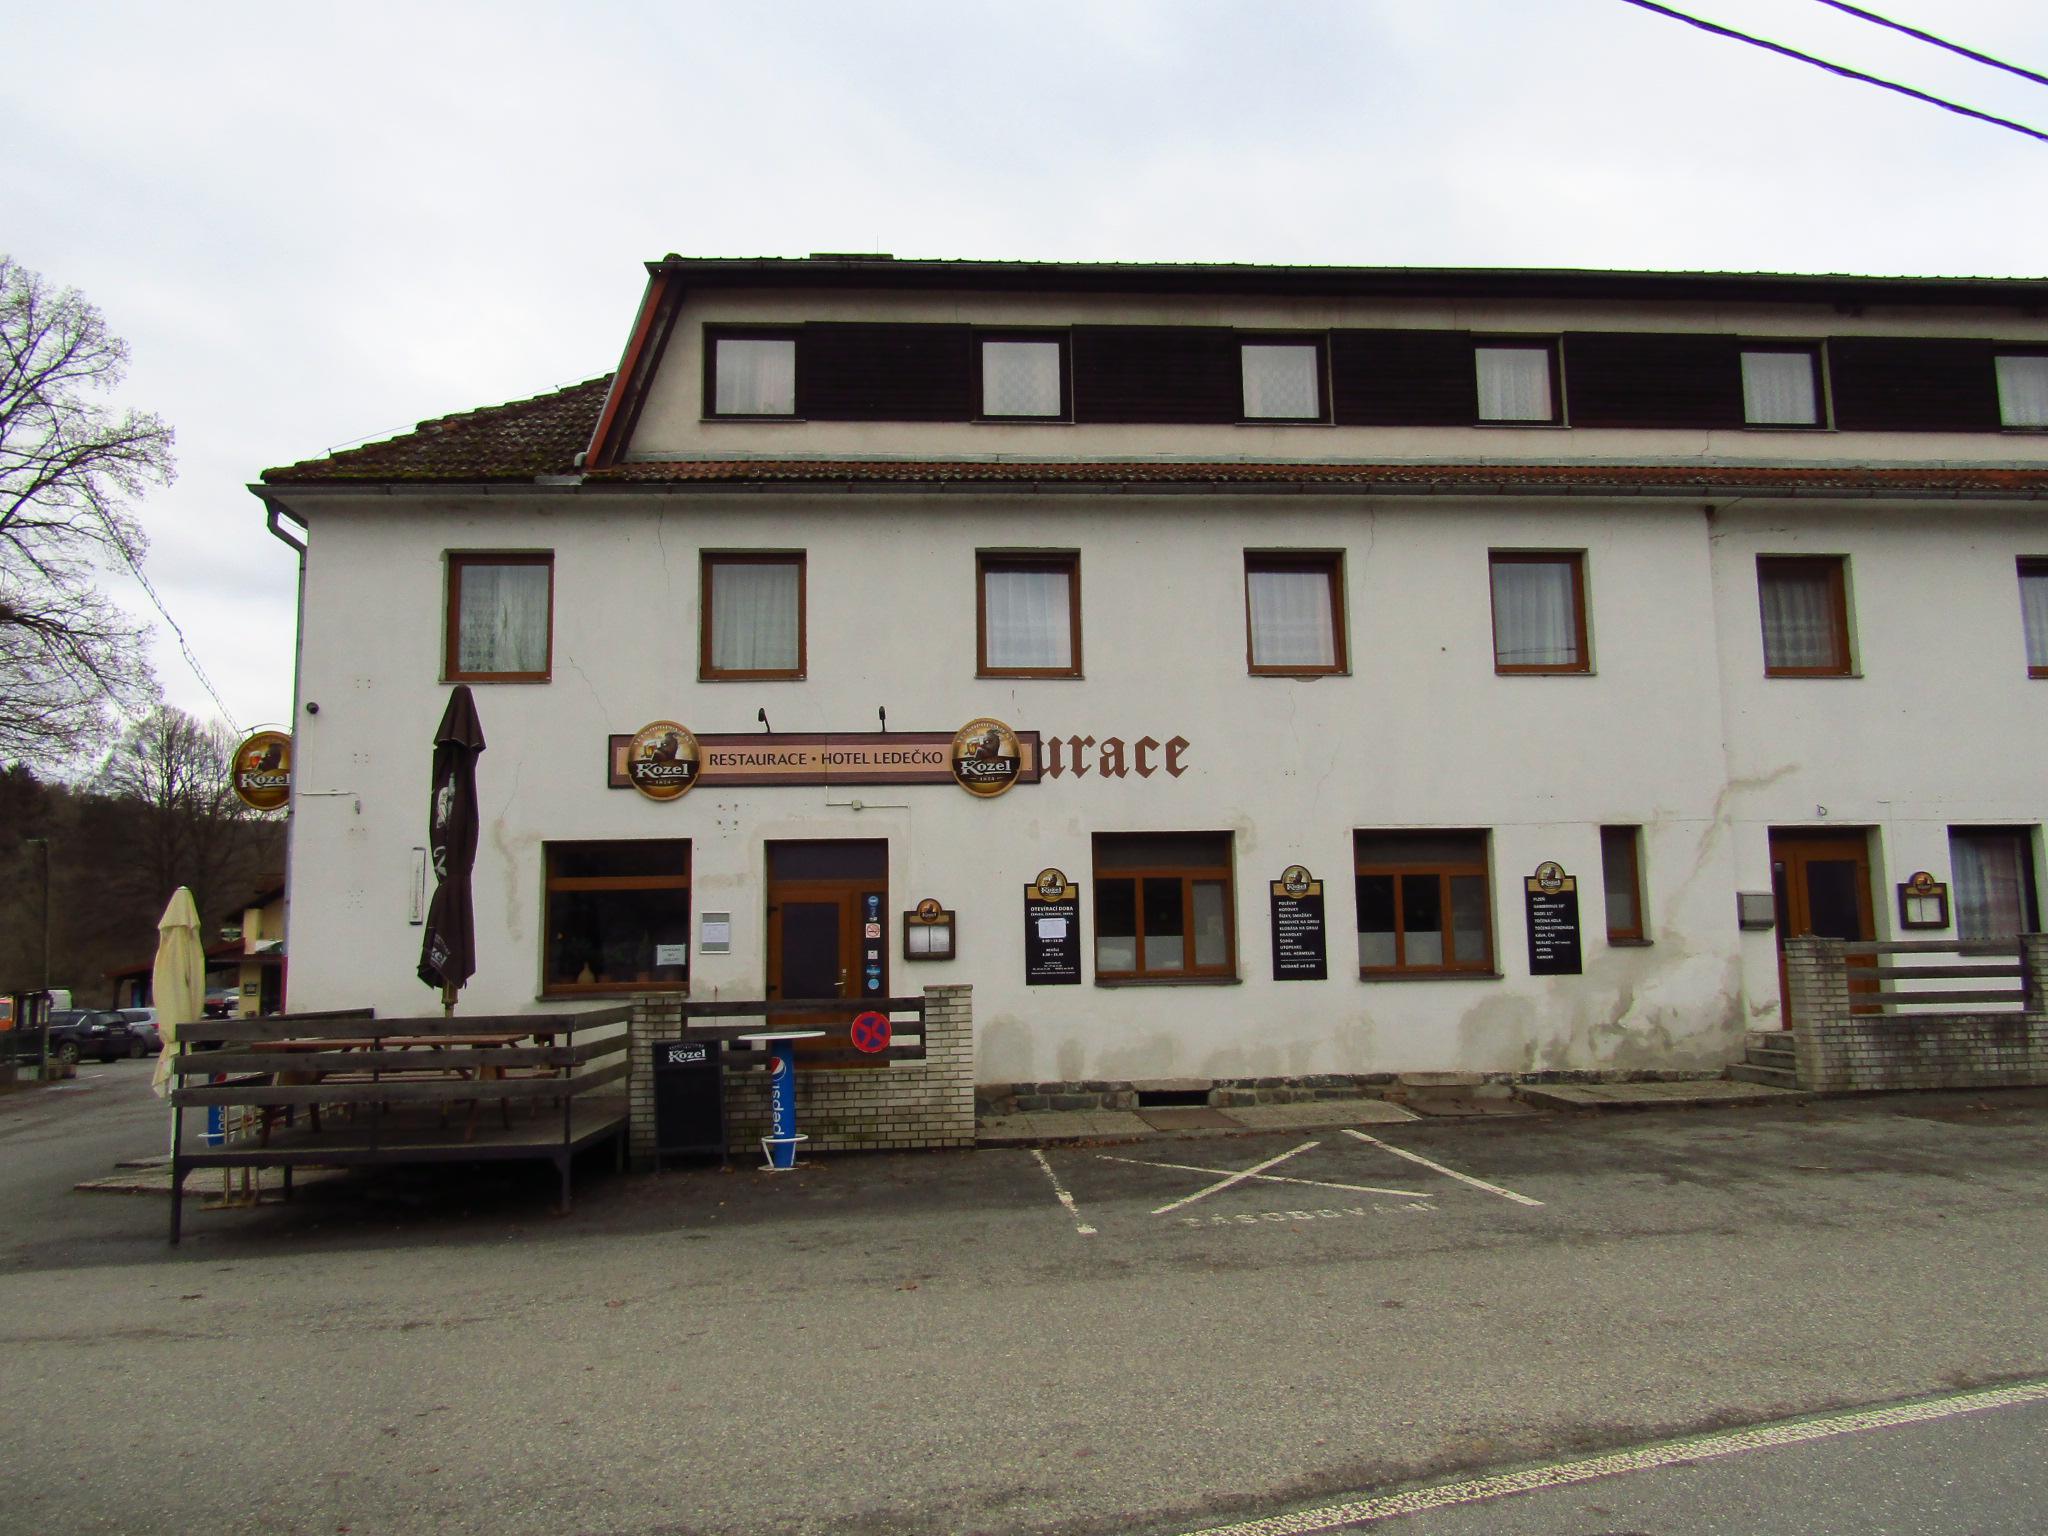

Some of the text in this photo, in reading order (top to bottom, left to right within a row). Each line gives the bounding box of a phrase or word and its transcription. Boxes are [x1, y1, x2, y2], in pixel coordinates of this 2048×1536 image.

[709, 749, 943, 766] RESTAURACE HOTEL LEDEČKO
[636, 763, 689, 778] Kozel
[960, 760, 1012, 775] Kozel
[241, 773, 291, 788] Kozel
[668, 1049, 707, 1063] Kozel
[772, 1085, 785, 1135] pepsi
